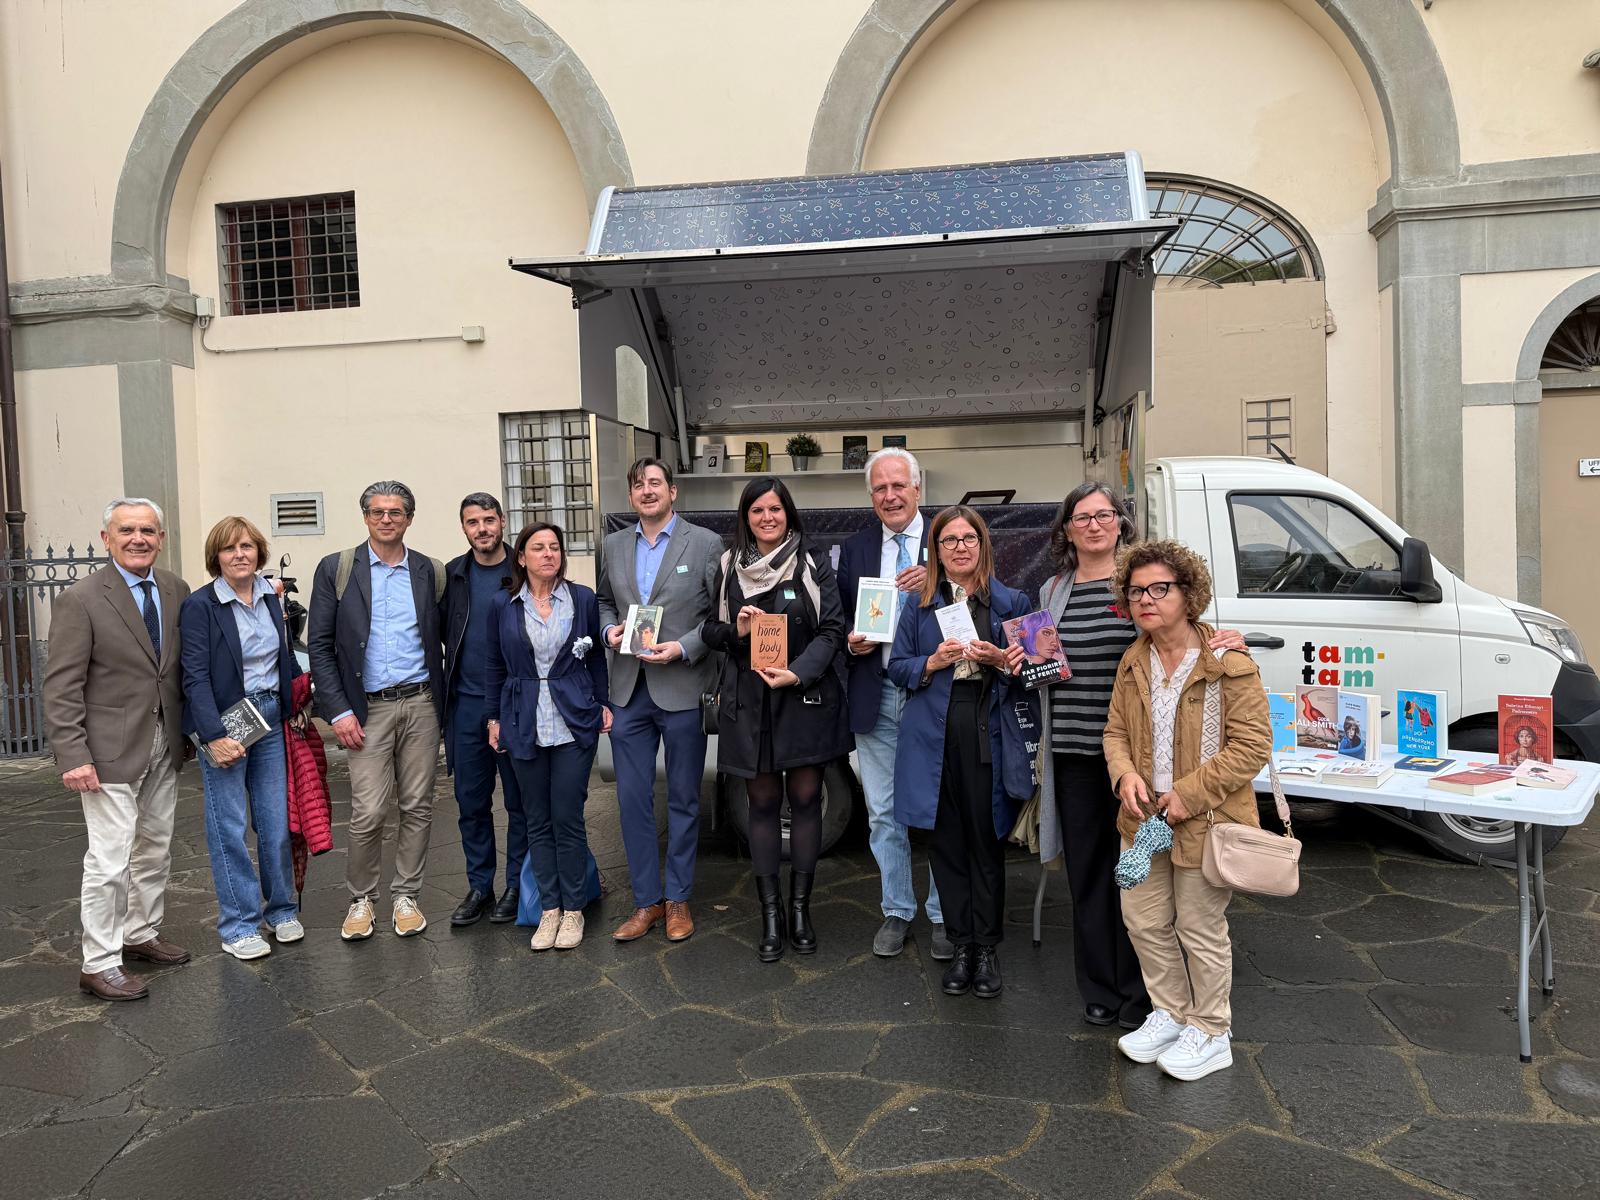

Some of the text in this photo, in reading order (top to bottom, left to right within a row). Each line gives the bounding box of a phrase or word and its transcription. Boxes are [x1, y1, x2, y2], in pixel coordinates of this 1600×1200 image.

[757, 622, 781, 637] home
[759, 638, 781, 664] body
[1022, 660, 1063, 677] FAR FIORIRE
[1038, 667, 1061, 679] FERITE
[1301, 665, 1374, 687] tam
[1296, 719, 1310, 727] ALI
